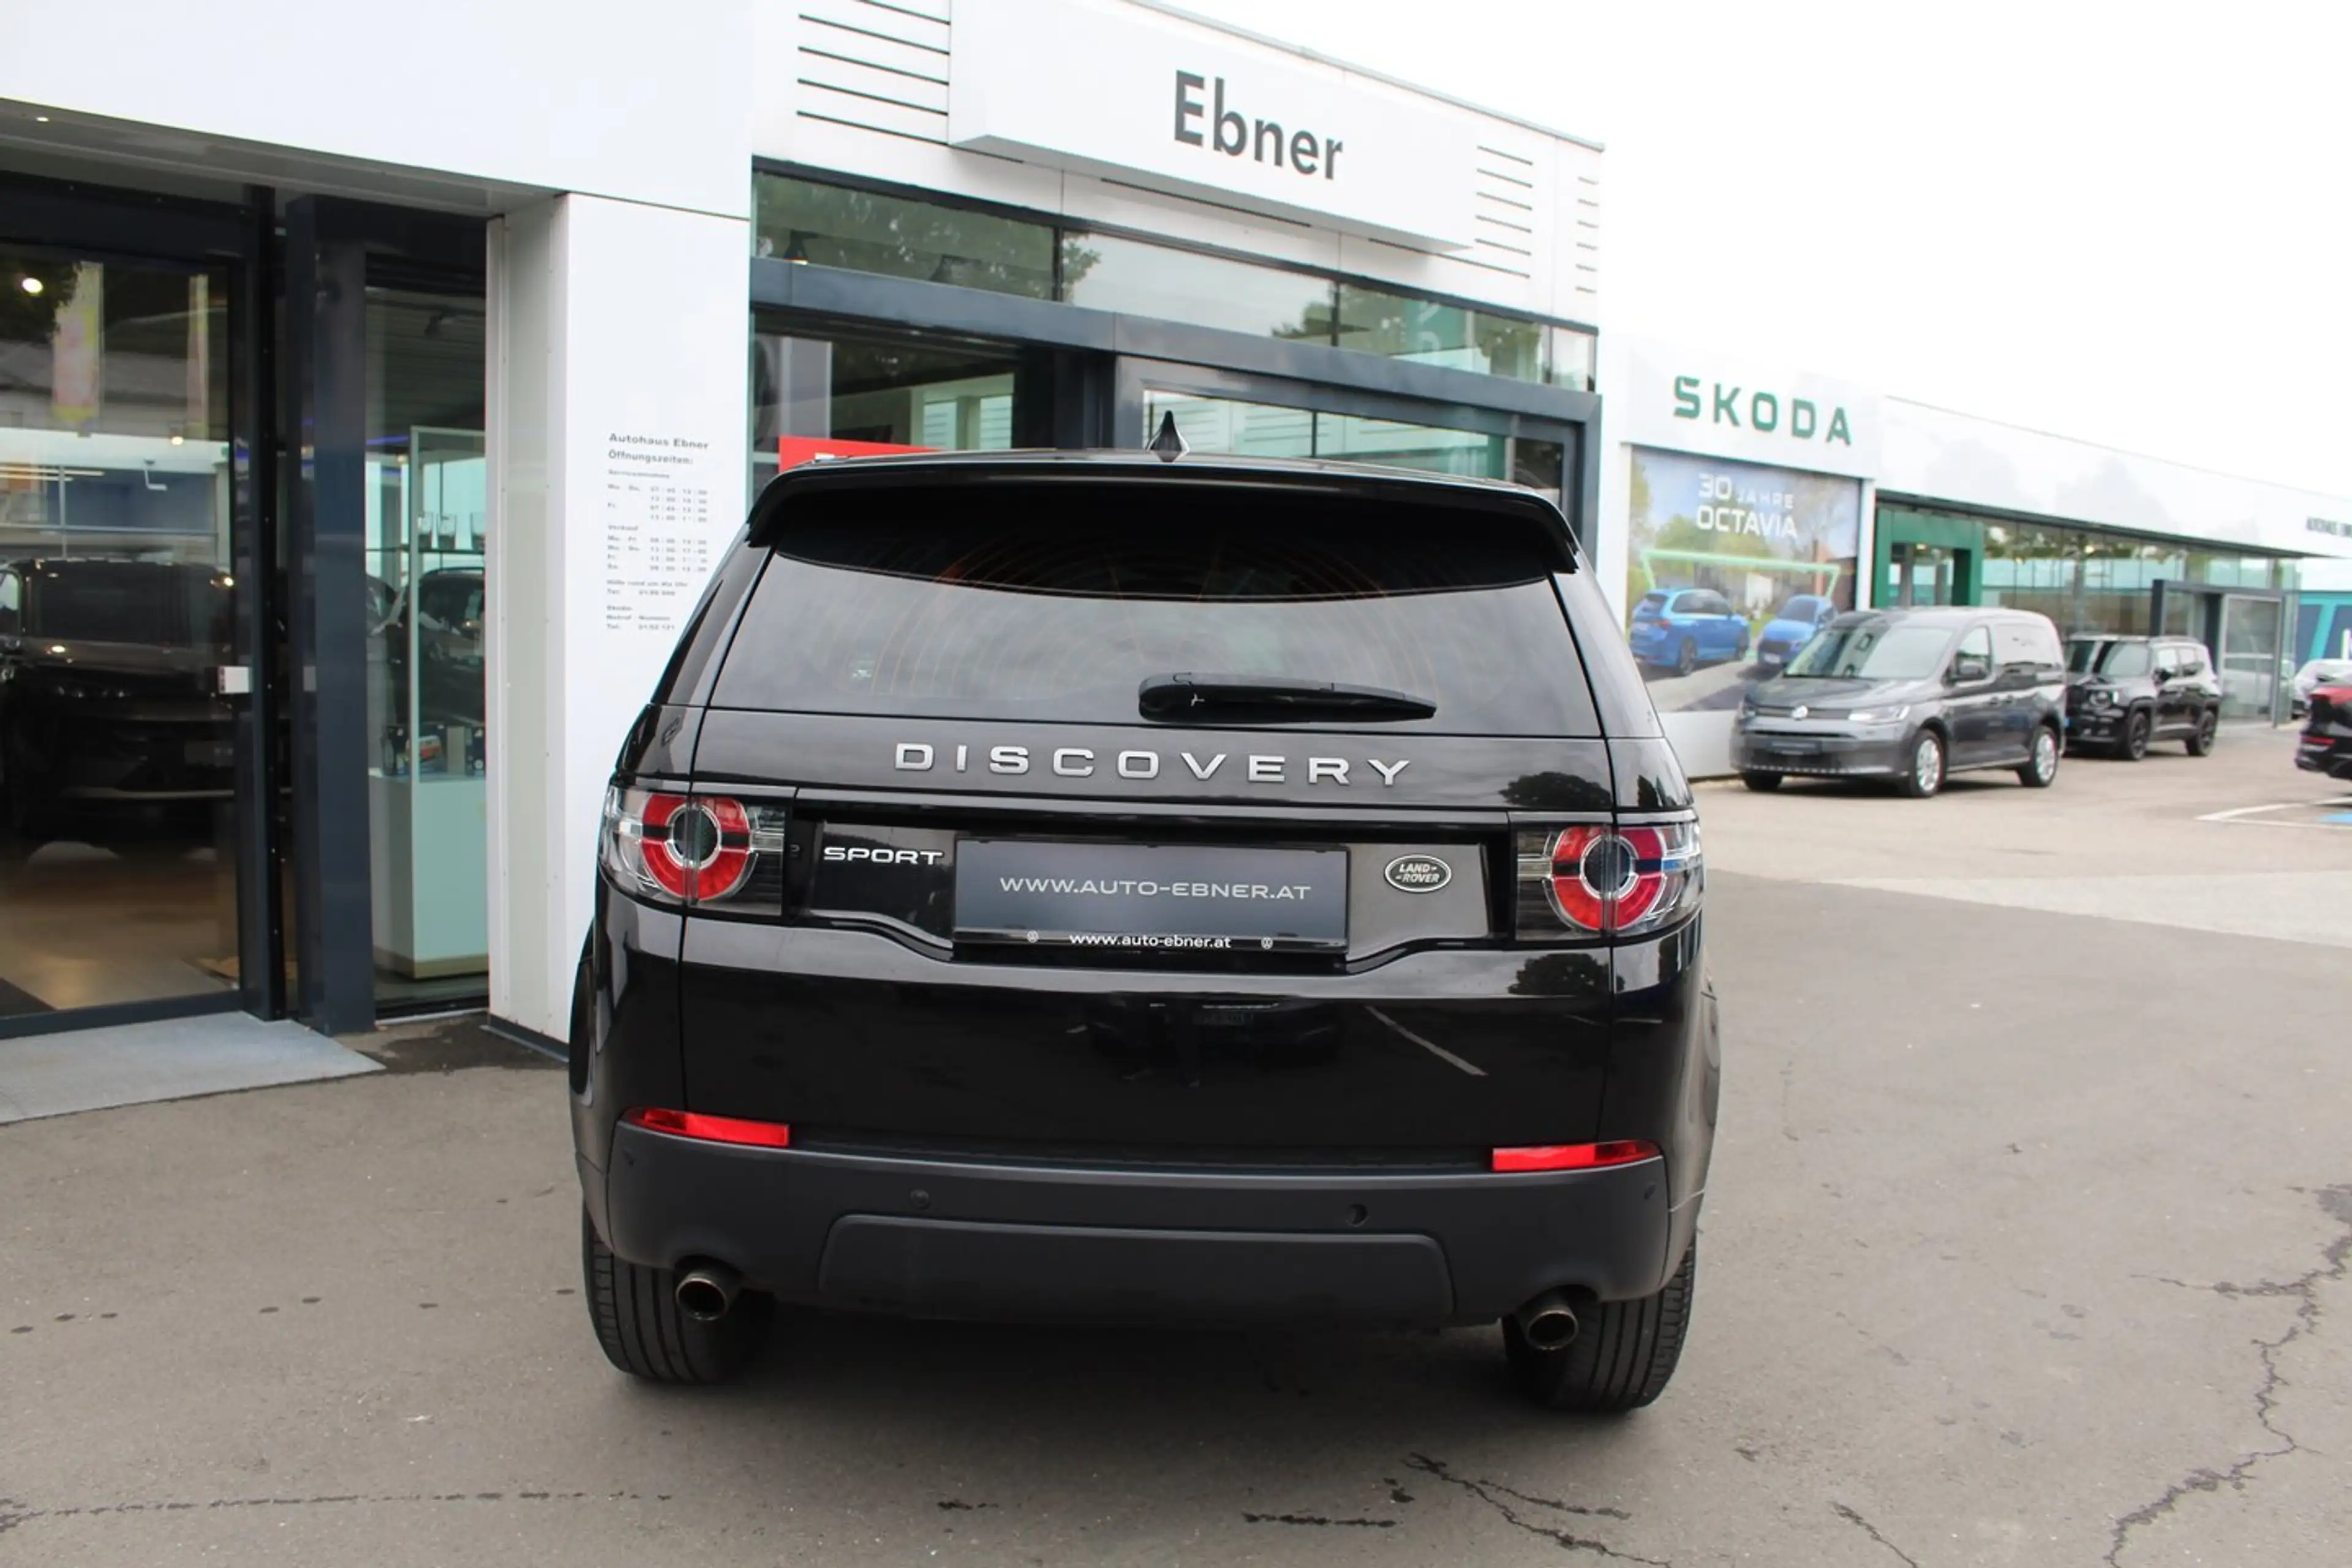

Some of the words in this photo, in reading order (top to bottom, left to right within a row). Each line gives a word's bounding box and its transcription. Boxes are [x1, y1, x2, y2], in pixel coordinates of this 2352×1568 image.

[1174, 69, 1343, 180] Ebner
[1673, 375, 1852, 446] SKODA
[609, 432, 669, 446] Autohaus
[673, 437, 709, 449] Ebner
[1698, 472, 1732, 501] 30
[1736, 488, 1794, 510] JAHRE
[1696, 504, 1798, 538] OCTAVIA
[895, 742, 1411, 786] DISCOVERY
[823, 846, 943, 865] SPORT
[1000, 877, 1311, 900] WWW.AUTO-EBNER.AT
[1069, 933, 1231, 949] www.auto-ebner.at
